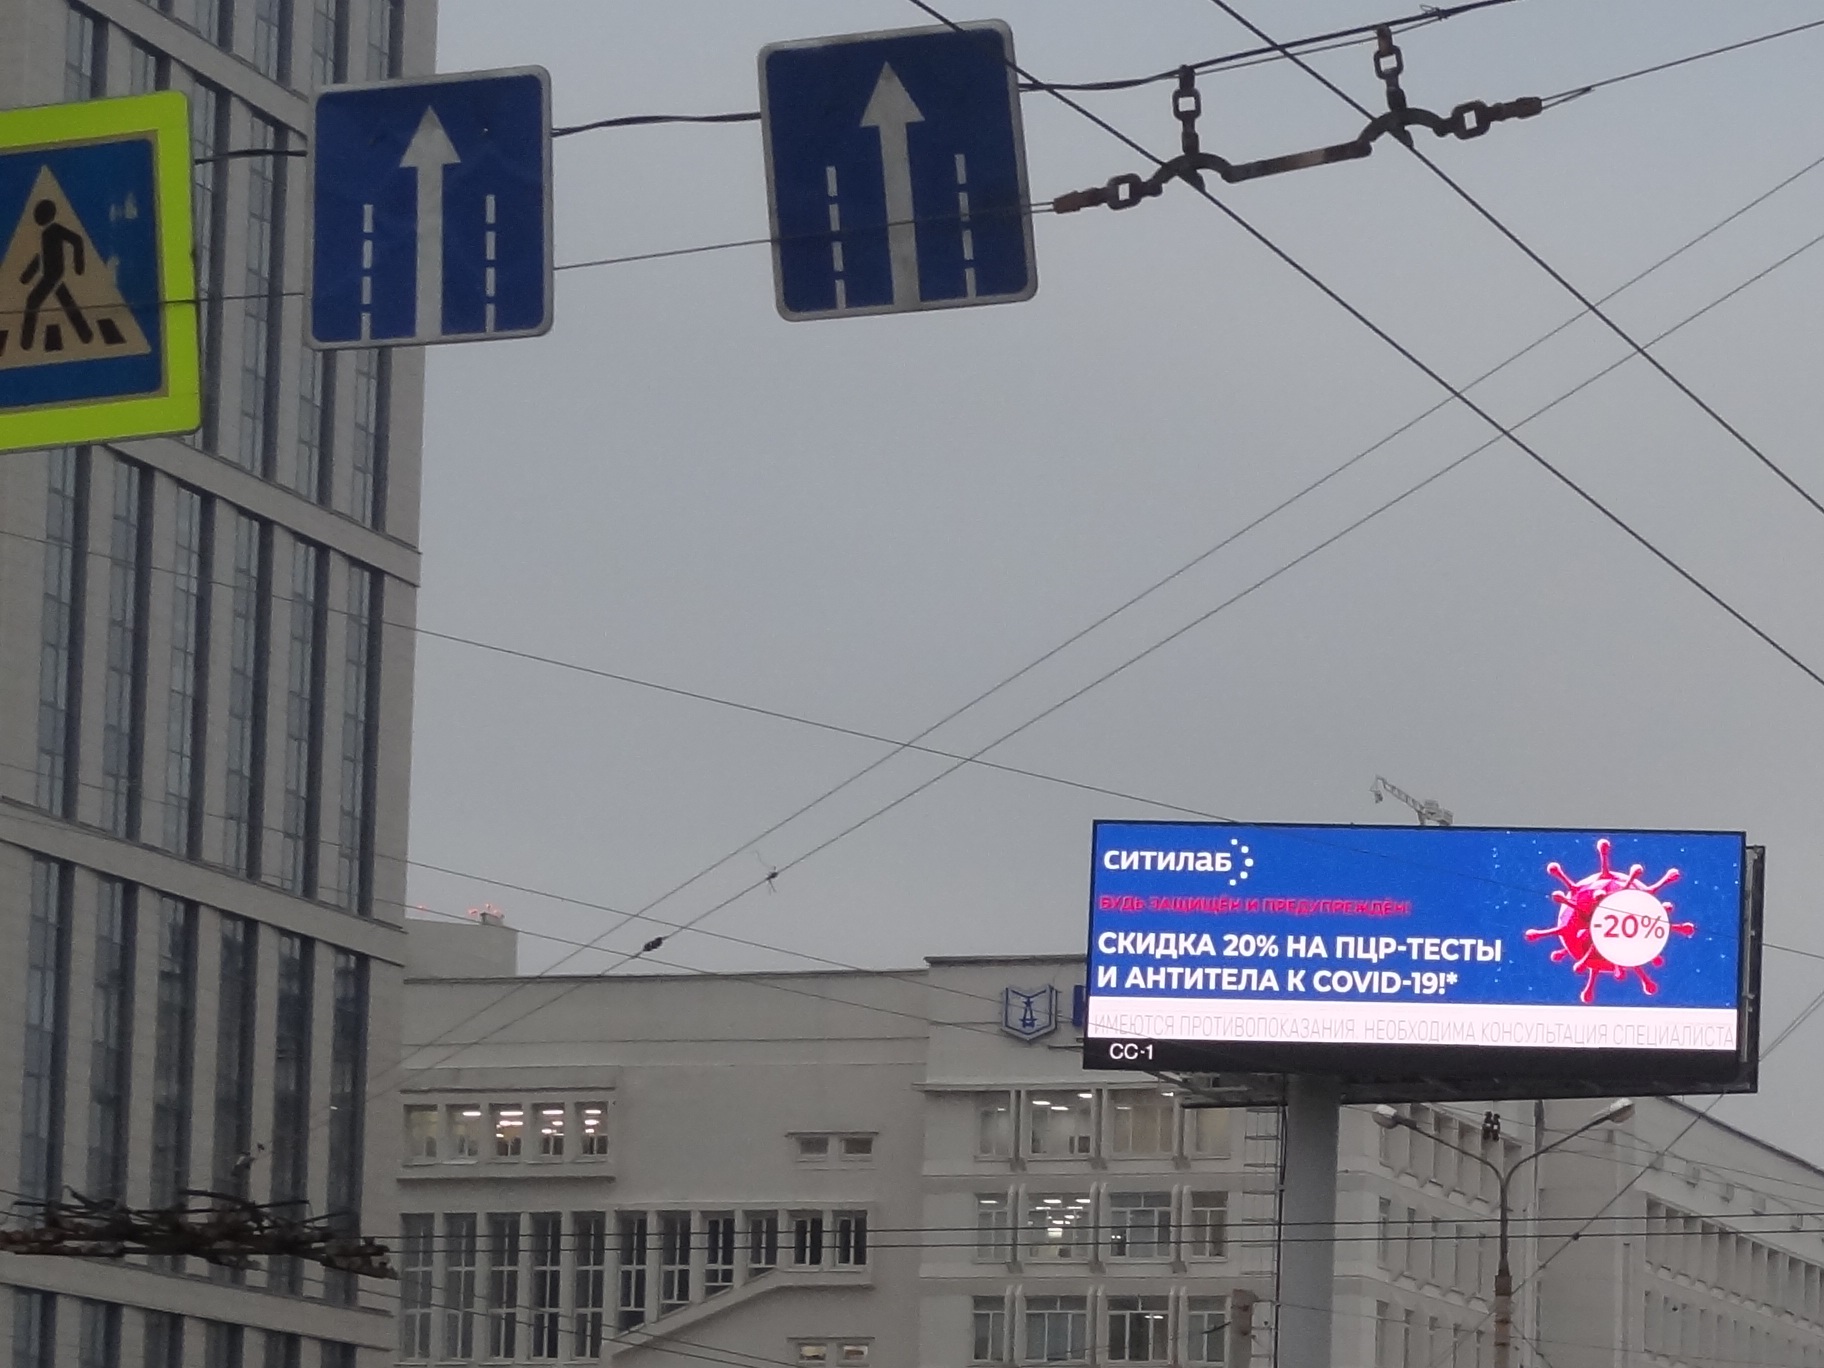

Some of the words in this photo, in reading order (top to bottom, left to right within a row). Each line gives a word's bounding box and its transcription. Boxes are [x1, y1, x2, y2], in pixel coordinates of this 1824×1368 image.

[1593, 913, 1665, 940] -20%
[1098, 931, 1217, 960] СКИДКА
[1222, 933, 1279, 958] 20%
[1286, 935, 1328, 959] НА
[1335, 936, 1503, 964] ПЦР-ТЕСТЫ
[1097, 965, 1118, 989] И
[1124, 966, 1280, 992] АНТИТЕЛА
[1287, 969, 1306, 993] К
[1094, 1013, 1175, 1037] ИМЕЮТСЯ
[1364, 1018, 1477, 1043] НЕОБХОДИМА
[1480, 1021, 1608, 1045] КОНСУЛЬТАЦИЯ
[1612, 1022, 1735, 1048] СПЕЦИАЛИСТА
